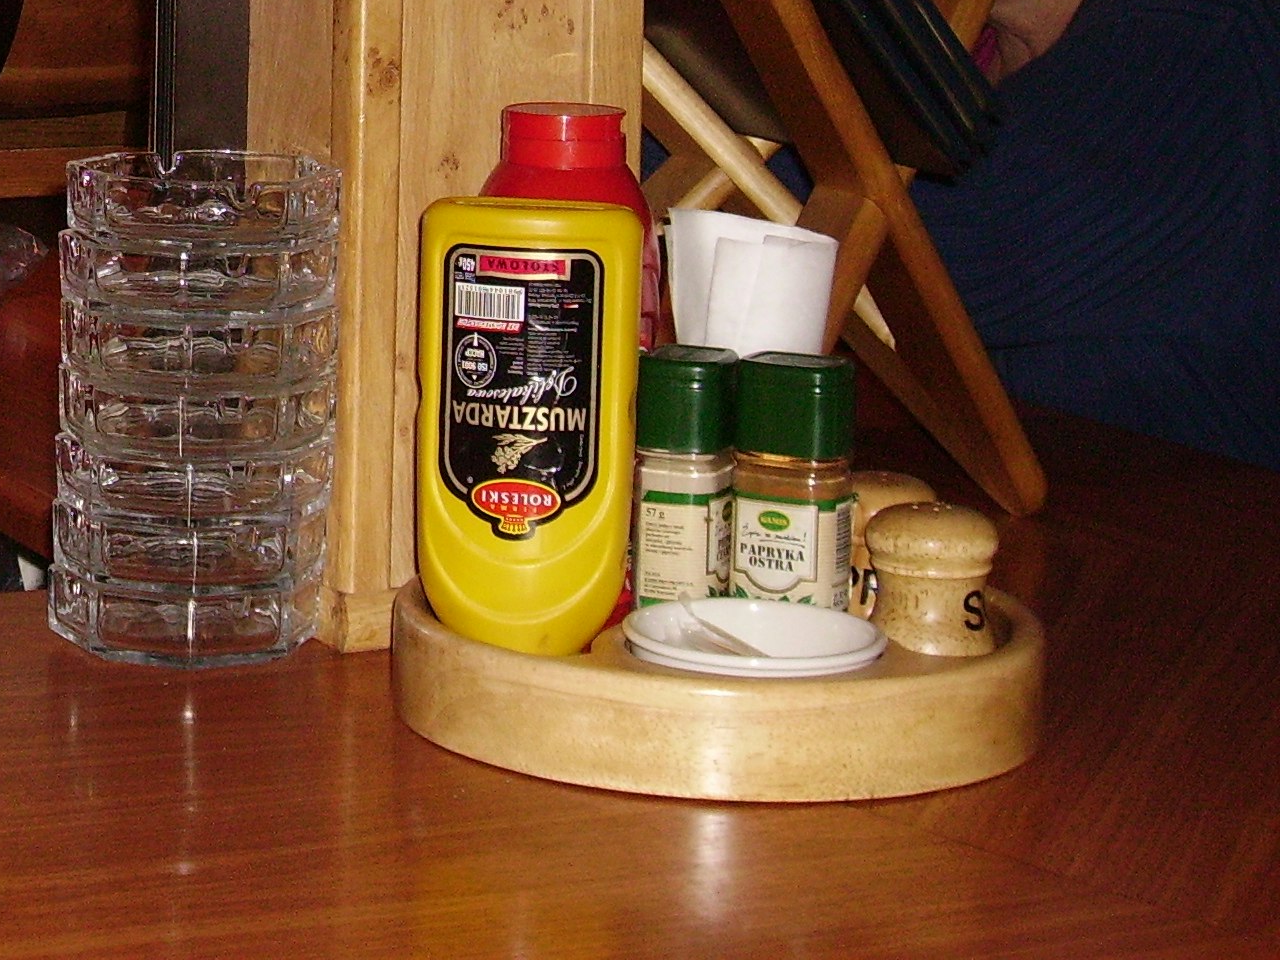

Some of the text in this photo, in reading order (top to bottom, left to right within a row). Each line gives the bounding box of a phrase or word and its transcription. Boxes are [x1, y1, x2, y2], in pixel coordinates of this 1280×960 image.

[451, 400, 587, 432] MUSZTARDA
[481, 489, 552, 507] ROLESKI
[645, 508, 657, 517] 57
[740, 542, 805, 562] PAPRYKA
[749, 555, 795, 572] OSTRA
[963, 590, 987, 631] S
